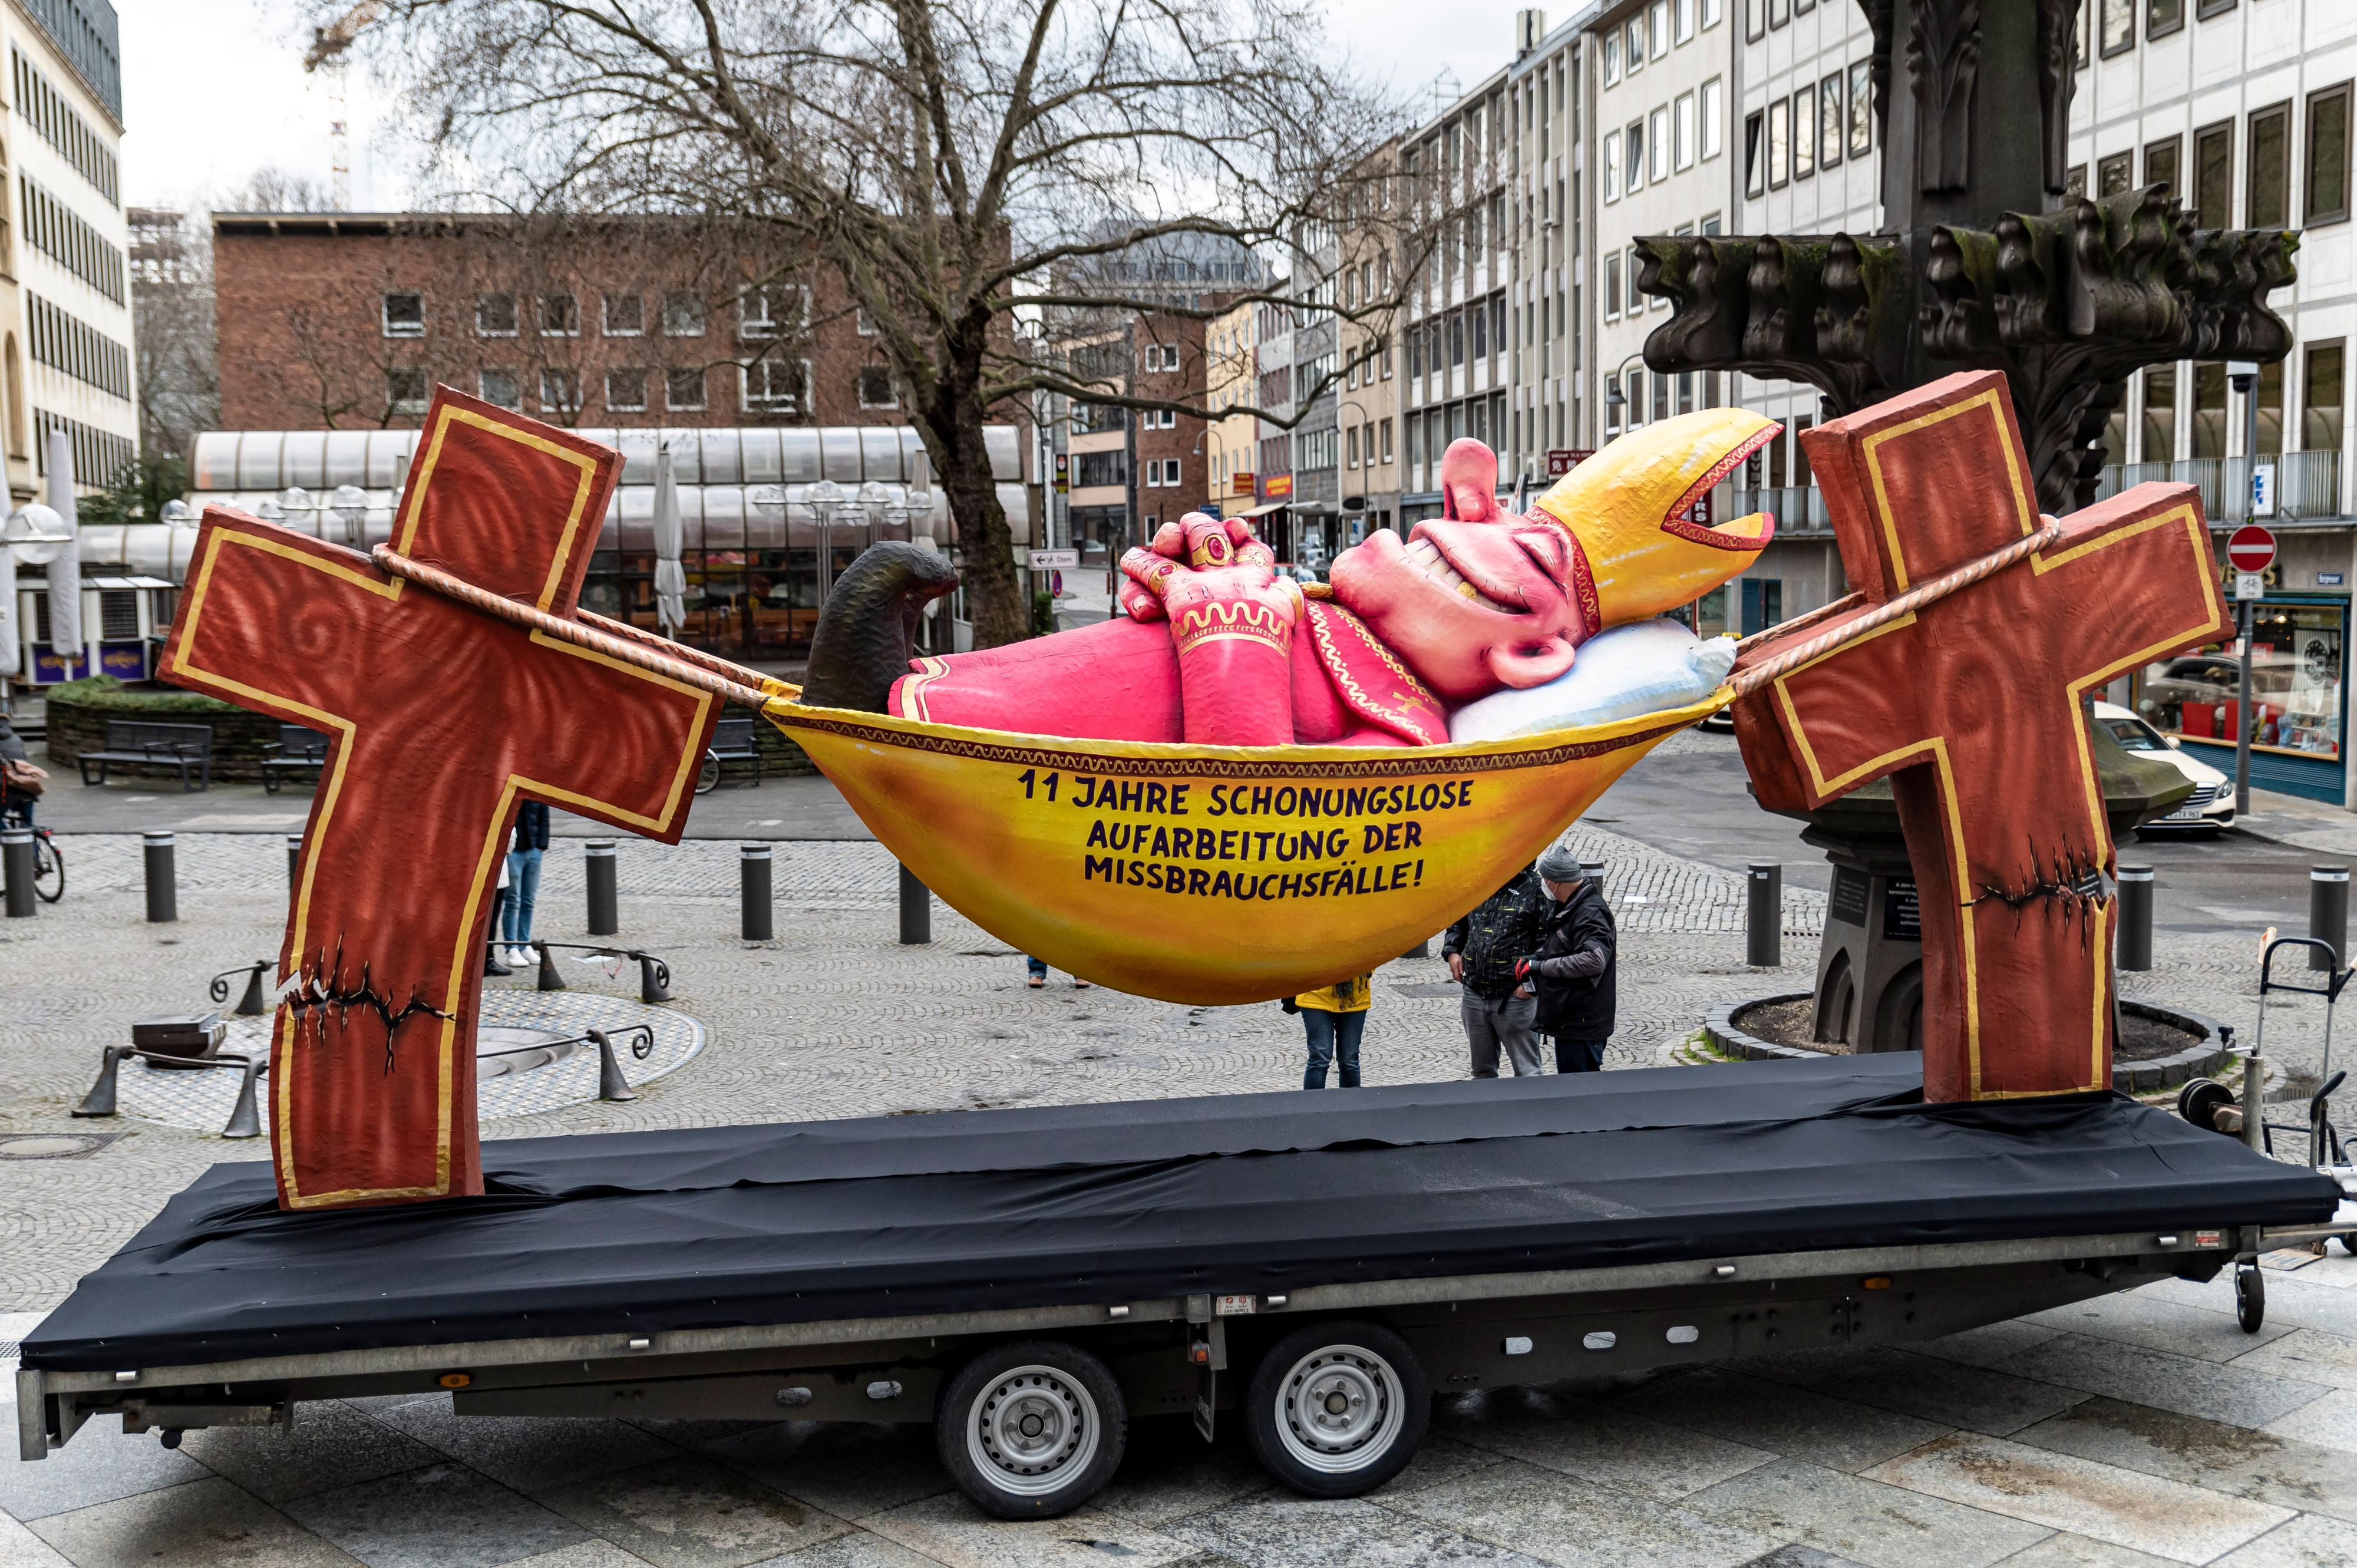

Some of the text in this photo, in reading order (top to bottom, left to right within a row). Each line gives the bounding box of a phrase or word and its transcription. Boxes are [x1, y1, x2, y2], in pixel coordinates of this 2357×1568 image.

[1018, 769, 1474, 817] 11 JAHRE SCHONUNGSLOSE
[1086, 820, 1421, 861] AUFARBEITUNG DER
[1085, 854, 1424, 900] MISSBRAUCHSFÄLLE!
